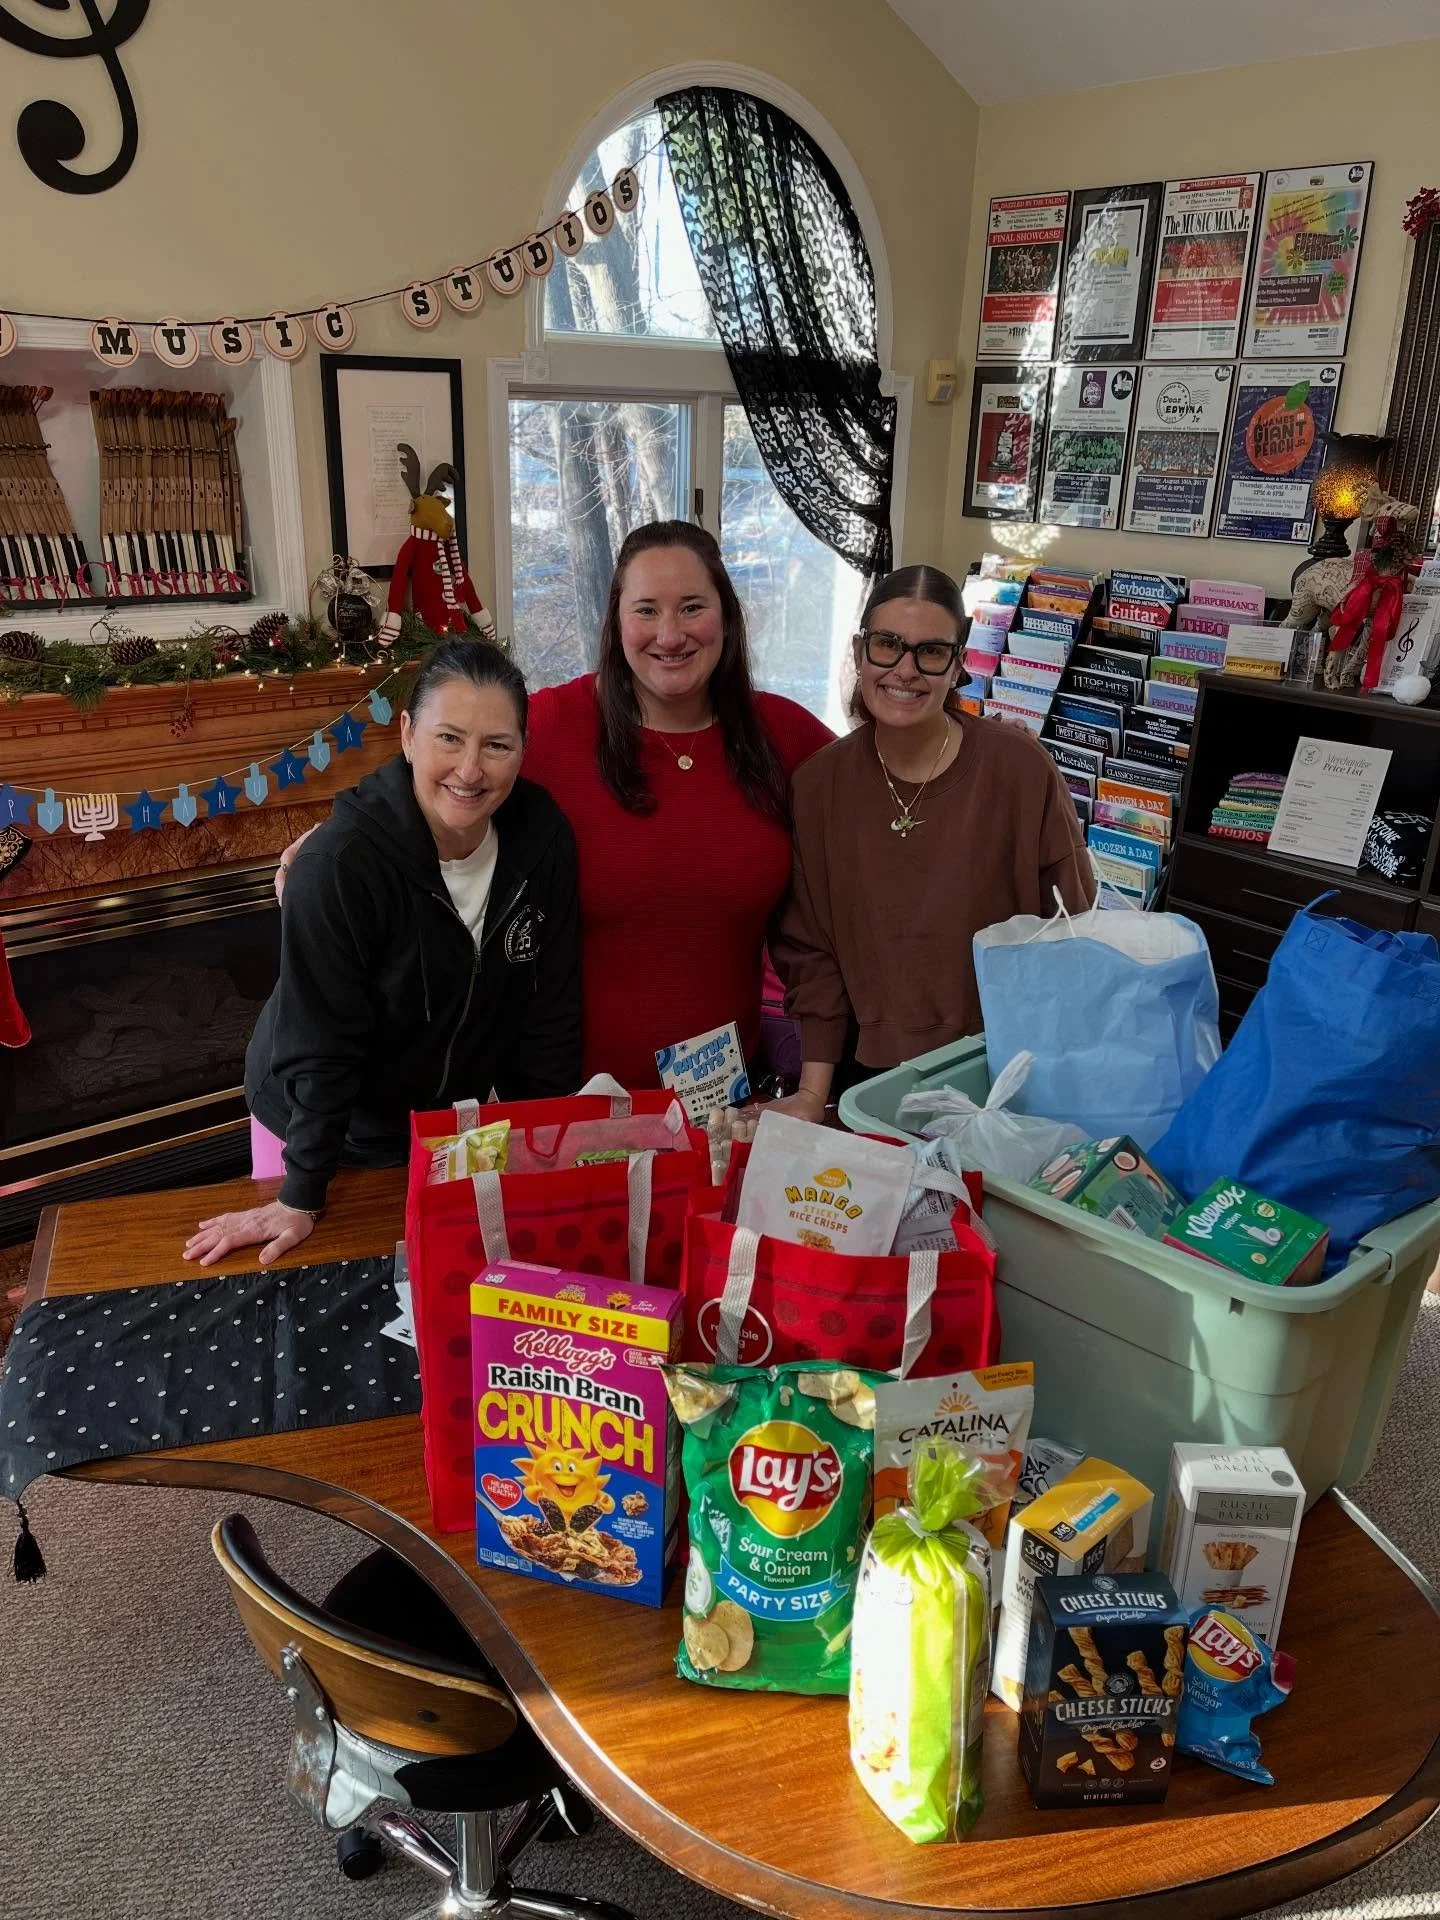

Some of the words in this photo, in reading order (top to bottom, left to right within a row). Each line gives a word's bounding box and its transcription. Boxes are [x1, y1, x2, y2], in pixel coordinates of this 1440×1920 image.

[1044, 197, 1066, 206] TALENT
[1164, 215, 1180, 235] The
[1181, 212, 1213, 234] MUSIC
[1237, 209, 1250, 229] Jr.
[993, 232, 1015, 243] FINAL
[1016, 230, 1061, 241] SHOWCASE!
[412, 178, 635, 316] STUDIOS
[98, 309, 345, 357] MUSIC
[1166, 406, 1203, 415] EDWINA
[1263, 415, 1295, 428] JAMES
[1253, 421, 1306, 443] GIANT
[1254, 439, 1295, 457] PEACH
[76, 561, 250, 598] Christmas
[1111, 579, 1165, 599] Keyboard
[1193, 595, 1259, 611] PERFORMANCE
[1109, 603, 1158, 624] Guitar
[1049, 625, 1072, 635] COURSE
[1181, 617, 1228, 638] THEO
[1073, 675, 1083, 688] 11
[1084, 675, 1104, 686] TOP
[1105, 681, 1129, 693] HITS
[1152, 699, 1195, 714] PERFORM
[1059, 726, 1074, 738] WEST
[1074, 729, 1087, 741] SIDE
[1088, 732, 1107, 746] STORY
[1322, 762, 1346, 773] Price
[1346, 764, 1364, 777] List
[1325, 752, 1373, 768] Merchandise
[1106, 768, 1134, 781] CLASSICS
[1108, 795, 1137, 808] DOZEN
[1139, 799, 1146, 809] A
[1147, 800, 1165, 811] DAY
[1242, 819, 1272, 830] TOMORROW
[1245, 812, 1275, 820] TOMORROW
[1208, 825, 1265, 842] STUDIOS
[1090, 840, 1097, 850] A
[1098, 841, 1127, 856] DOZEN
[1128, 846, 1135, 856] A
[1136, 848, 1153, 860] DAY
[673, 1031, 731, 1076] RHYTHM
[692, 1051, 726, 1081] KITS
[784, 1185, 863, 1220] MANGO
[803, 1205, 840, 1219] STICKY
[789, 1210, 811, 1223] RICE
[814, 1217, 848, 1234] CRISPS
[1185, 1186, 1246, 1239] Kleenex
[1219, 1212, 1242, 1231] Lotion
[499, 1299, 582, 1328] FAMILY
[589, 1315, 639, 1340] SIZE
[514, 1329, 617, 1374] Kellogg's
[489, 1364, 571, 1395] Raisin
[576, 1379, 644, 1420] Bran
[478, 1391, 653, 1474] CRUNCH
[898, 1413, 1010, 1444] CATALINA
[1209, 1454, 1264, 1465] RUSTIC
[1213, 1464, 1271, 1474] BAKERY
[490, 1480, 513, 1492] HEART
[738, 1445, 835, 1512] Lay's
[487, 1485, 518, 1499] HEALTHY
[1220, 1500, 1272, 1511] RUSTIC
[1218, 1510, 1271, 1521] BAKERY
[1054, 1523, 1071, 1540] 365
[738, 1537, 773, 1559] Sour
[775, 1546, 828, 1563] Cream
[1024, 1539, 1056, 1569] 365
[749, 1558, 761, 1572] &
[764, 1561, 811, 1576] Onion
[763, 1575, 795, 1584] Flavored
[727, 1575, 786, 1612] PARTY
[790, 1589, 834, 1611] SIZE
[1060, 1593, 1115, 1613] CHEESE
[1114, 1592, 1168, 1610] STICKS
[1096, 1611, 1119, 1623] Original
[1120, 1610, 1147, 1620] Cheddar
[1190, 1618, 1259, 1669] Lay's
[1191, 1675, 1210, 1692] Salt
[1211, 1686, 1219, 1697] &
[1186, 1684, 1223, 1710] Vinegar
[1056, 1699, 1115, 1721] CHEESE
[1119, 1698, 1175, 1716] STICKS
[1081, 1719, 1112, 1734] Original
[1111, 1718, 1146, 1731] Cheddar
